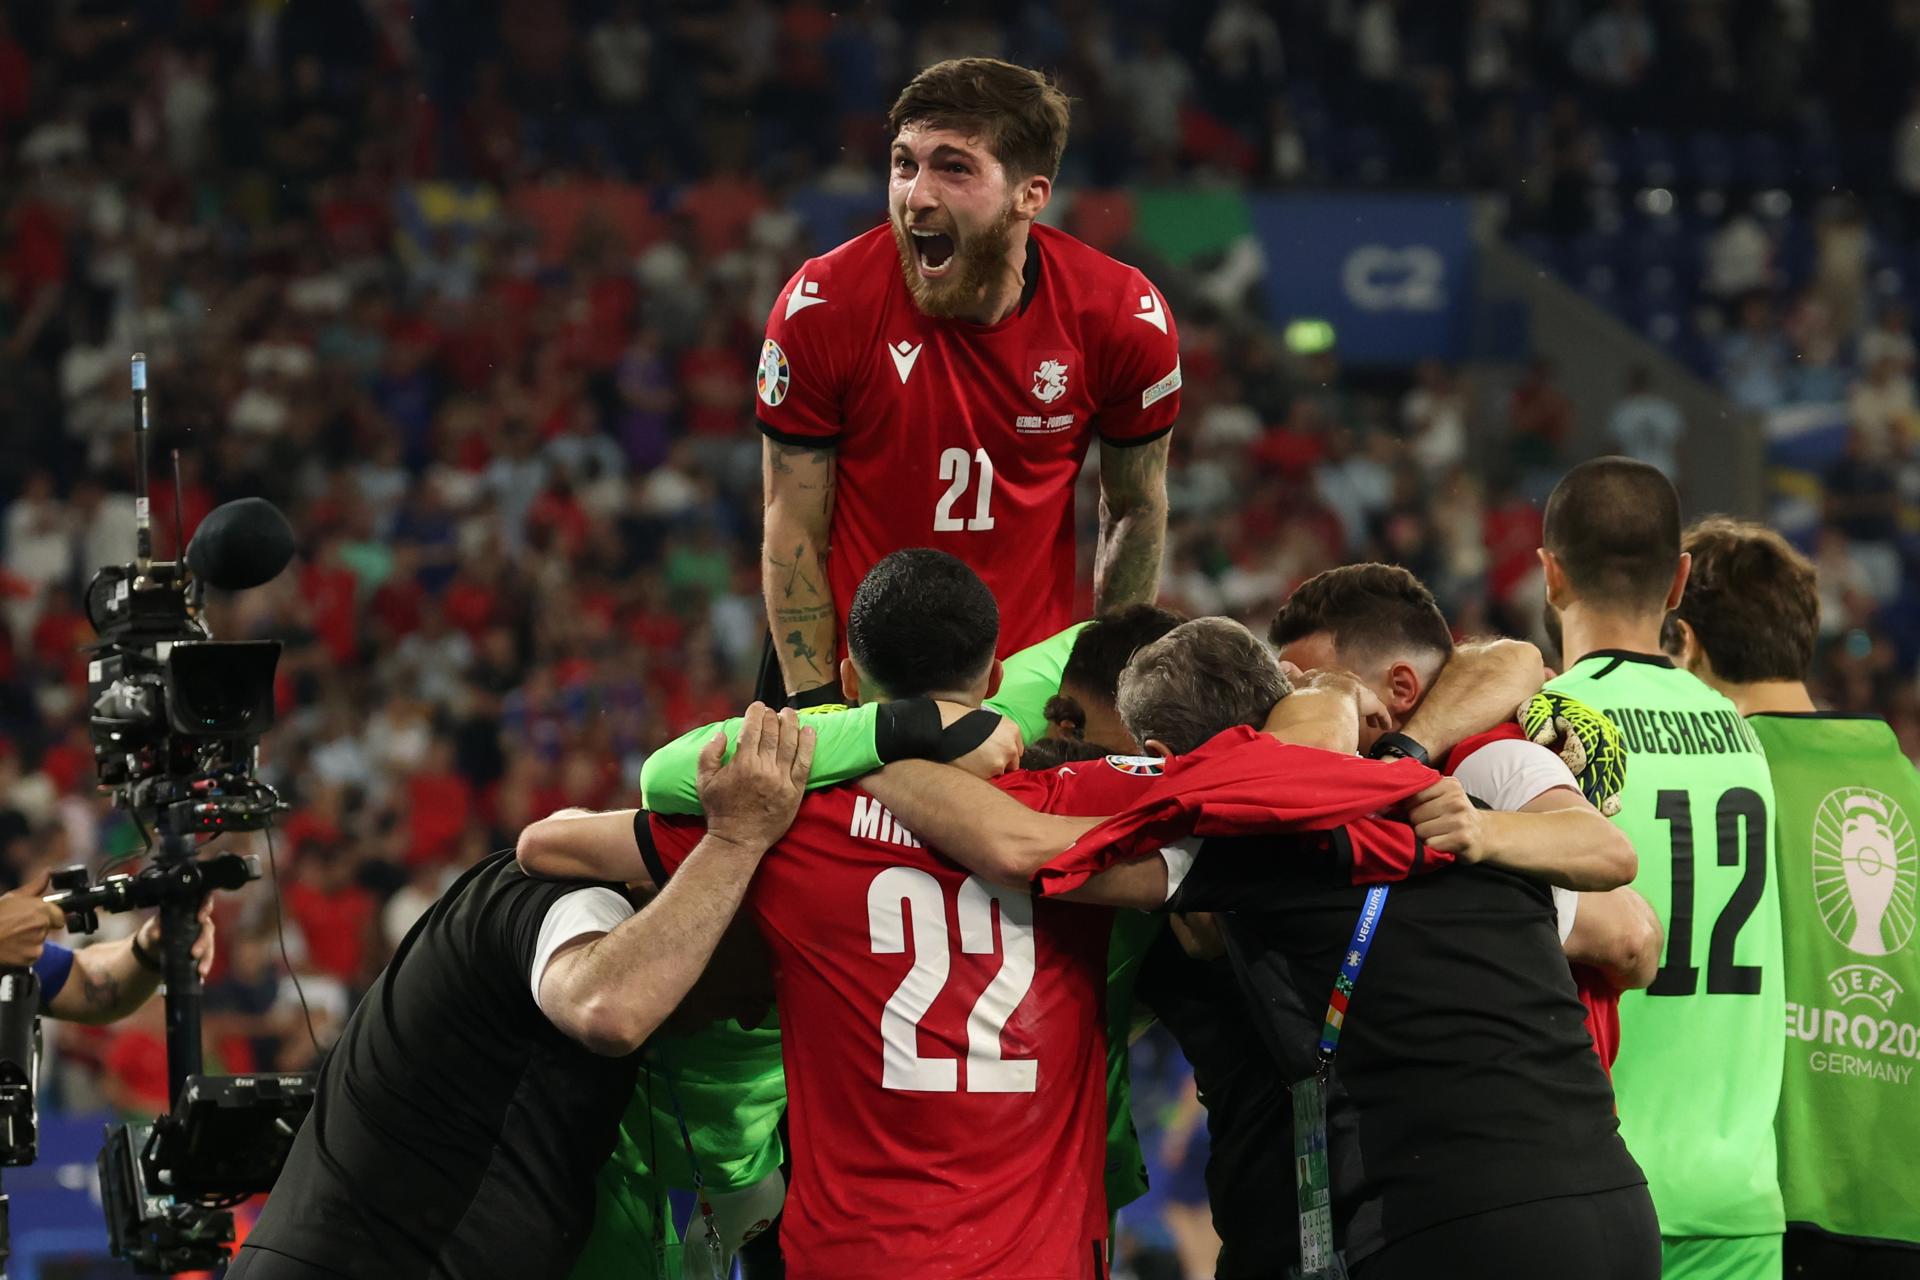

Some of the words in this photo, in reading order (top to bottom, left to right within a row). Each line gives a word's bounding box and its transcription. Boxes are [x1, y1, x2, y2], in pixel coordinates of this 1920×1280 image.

[1344, 246, 1444, 312] C2
[934, 448, 994, 531] 21
[850, 795, 921, 849] MI
[1357, 886, 1384, 943] UEFAEURO
[1646, 787, 1766, 995] 12
[867, 866, 1038, 1092] 22
[1831, 971, 1896, 1007] UEFA
[1786, 1003, 1920, 1059] EURO20
[1810, 1051, 1913, 1084] GERMANY
